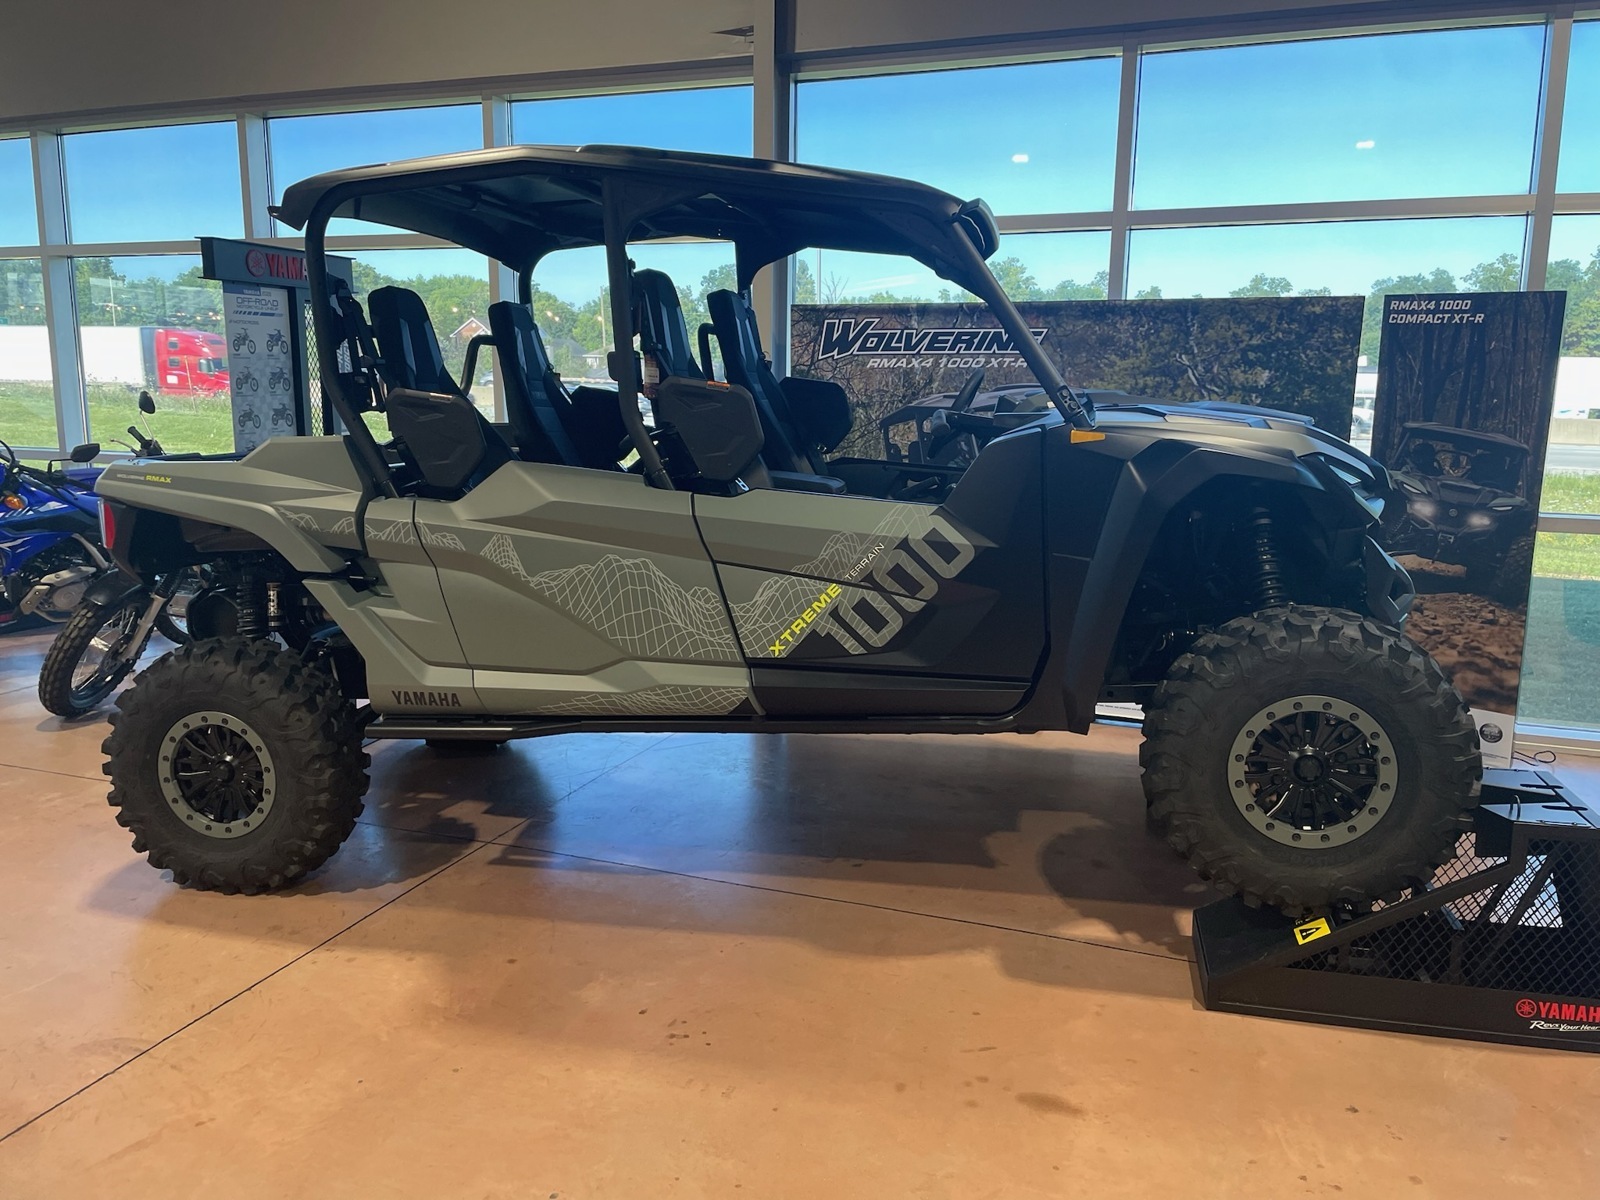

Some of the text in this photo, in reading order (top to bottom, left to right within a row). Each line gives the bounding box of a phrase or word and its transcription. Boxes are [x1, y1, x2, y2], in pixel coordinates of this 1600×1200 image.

[266, 253, 309, 280] YAMA
[236, 297, 279, 307] OFF-ROAD
[1390, 300, 1471, 310] RMAX4 1000
[1389, 313, 1484, 324] COMPACT XT-R
[867, 358, 932, 368] RMAX4
[939, 358, 985, 368] 1000
[146, 475, 172, 483] RMAX
[844, 542, 885, 581] TERRAIN
[814, 515, 975, 655] 1000
[769, 583, 842, 657] XTREME
[391, 690, 462, 707] YAMAHA
[1539, 1002, 1600, 1022] YAMAH
